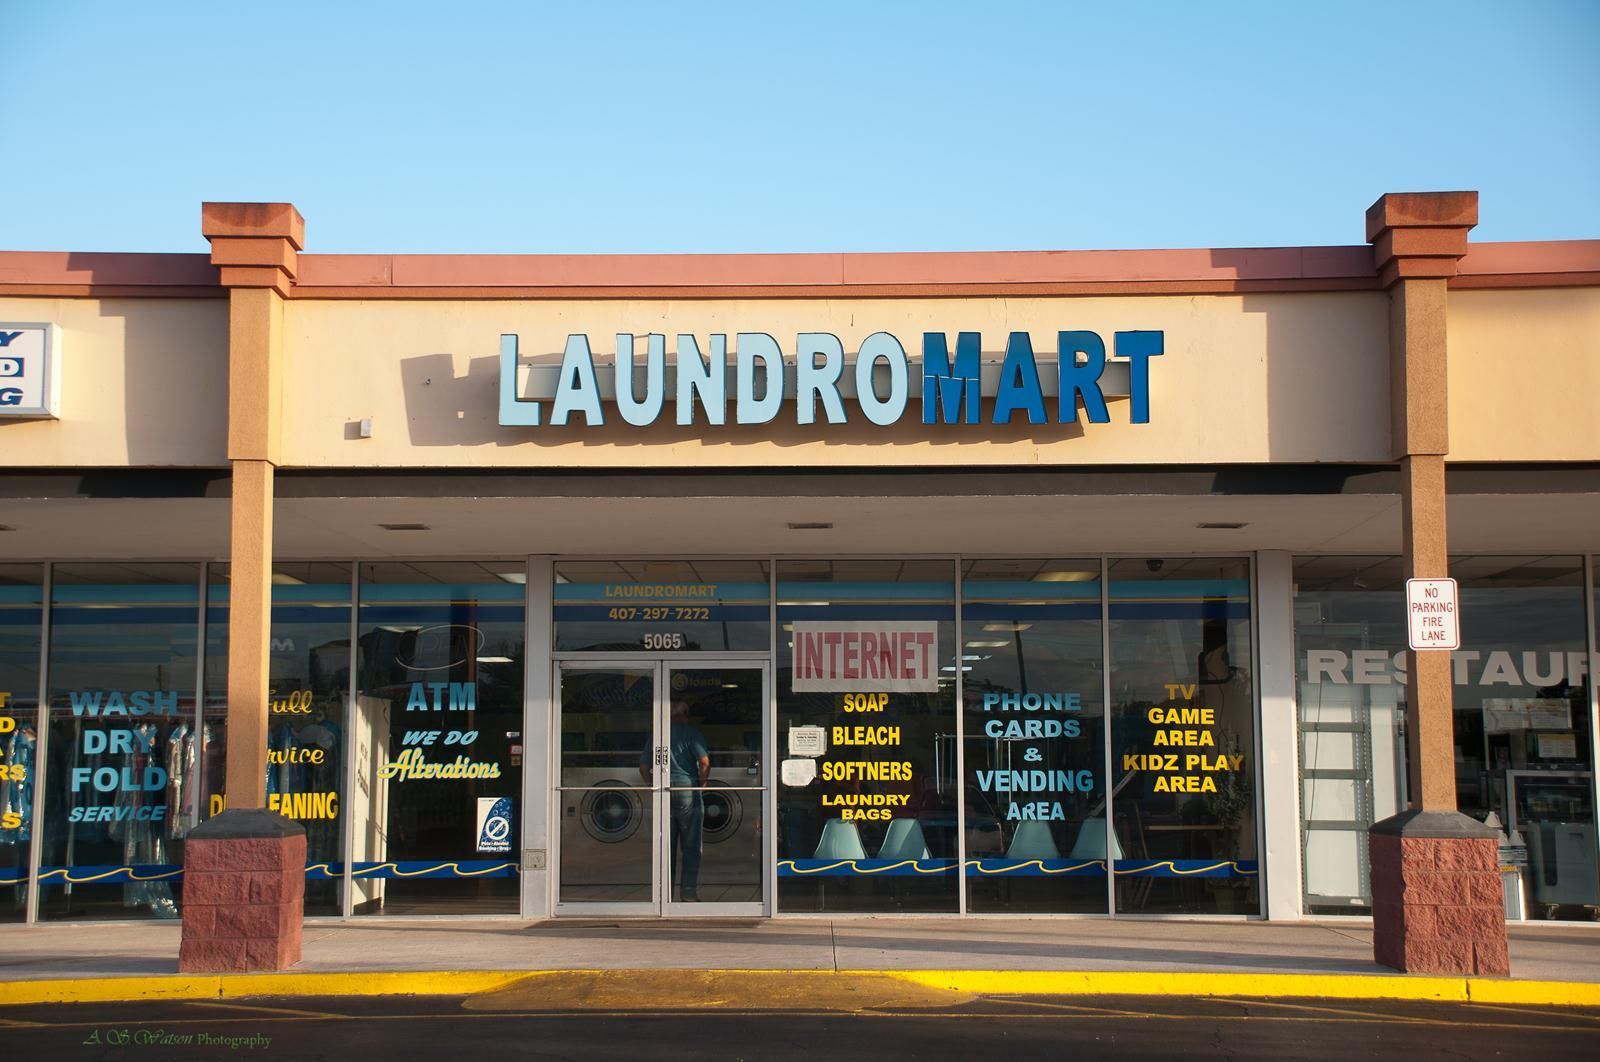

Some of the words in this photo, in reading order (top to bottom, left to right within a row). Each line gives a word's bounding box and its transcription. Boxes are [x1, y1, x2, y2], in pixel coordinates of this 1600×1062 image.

[499, 331, 1165, 426] LAUNDROMART
[605, 585, 717, 598] LAUNDROMART
[1425, 587, 1439, 598] NO
[608, 607, 710, 620] 407-297-7272
[1412, 602, 1453, 613] PARKING
[1423, 616, 1443, 627] FIRE
[644, 633, 682, 650] 5065
[1421, 630, 1446, 641] LANE
[796, 632, 934, 679] INTERNET
[406, 682, 476, 711] ATM
[1165, 684, 1196, 700] TV
[69, 691, 178, 717] WASH
[843, 693, 889, 712] SOAP
[983, 693, 1082, 711] PHONE
[1148, 707, 1215, 725] GAME
[832, 726, 901, 746] BLEACH
[985, 719, 1081, 738] CARDS
[84, 729, 157, 754] DRY
[402, 730, 441, 746] WE
[443, 730, 479, 746] DO
[1153, 730, 1215, 746] AREA
[1023, 747, 1043, 761] &
[1123, 754, 1179, 771] KIDZ
[1185, 754, 1245, 771] PLAY
[376, 747, 502, 782] Alterations
[822, 761, 913, 781] SOFTNERS
[72, 767, 167, 793] FOLD
[976, 770, 1094, 792] VENDING
[1153, 776, 1217, 792] AREA
[822, 794, 911, 806] LAUNDRY
[68, 805, 167, 823] SERVICE
[841, 808, 892, 821] BAGS
[1006, 801, 1065, 821] AREA
